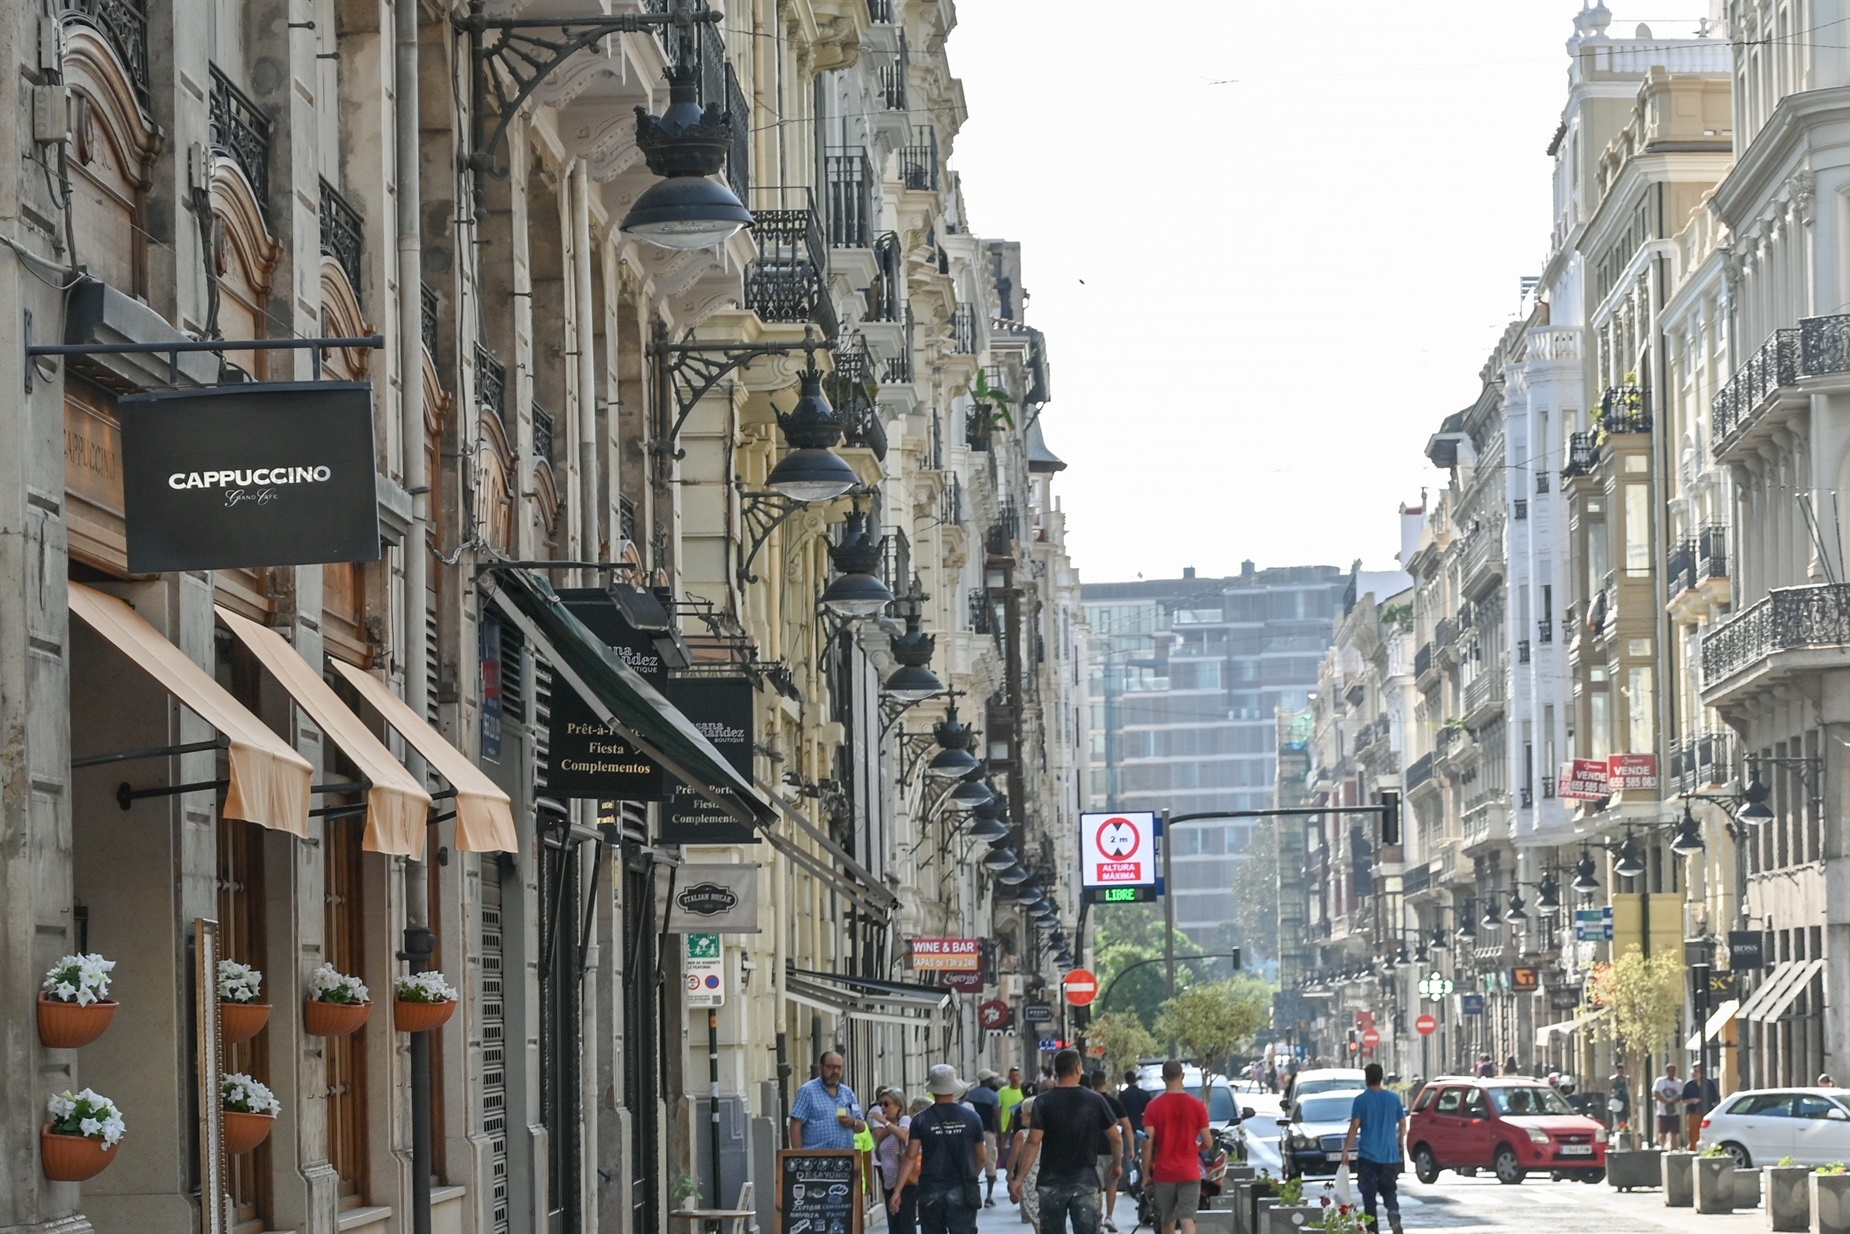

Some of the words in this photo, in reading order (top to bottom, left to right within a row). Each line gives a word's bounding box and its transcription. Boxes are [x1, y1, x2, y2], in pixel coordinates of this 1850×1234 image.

[64, 428, 115, 480] APPUCCINO
[168, 465, 332, 490] CAPPUCCINO
[588, 741, 625, 755] Fiesta
[560, 759, 651, 775] Complementos
[1613, 766, 1650, 776] VENDE
[1576, 770, 1607, 782] VENDE
[1102, 863, 1136, 872] ALTURA
[1105, 888, 1135, 901] LIBRE
[913, 941, 940, 953] WINE
[942, 941, 950, 953] &
[952, 941, 975, 953] BAR
[796, 1171, 850, 1180] DESAYUNOS
